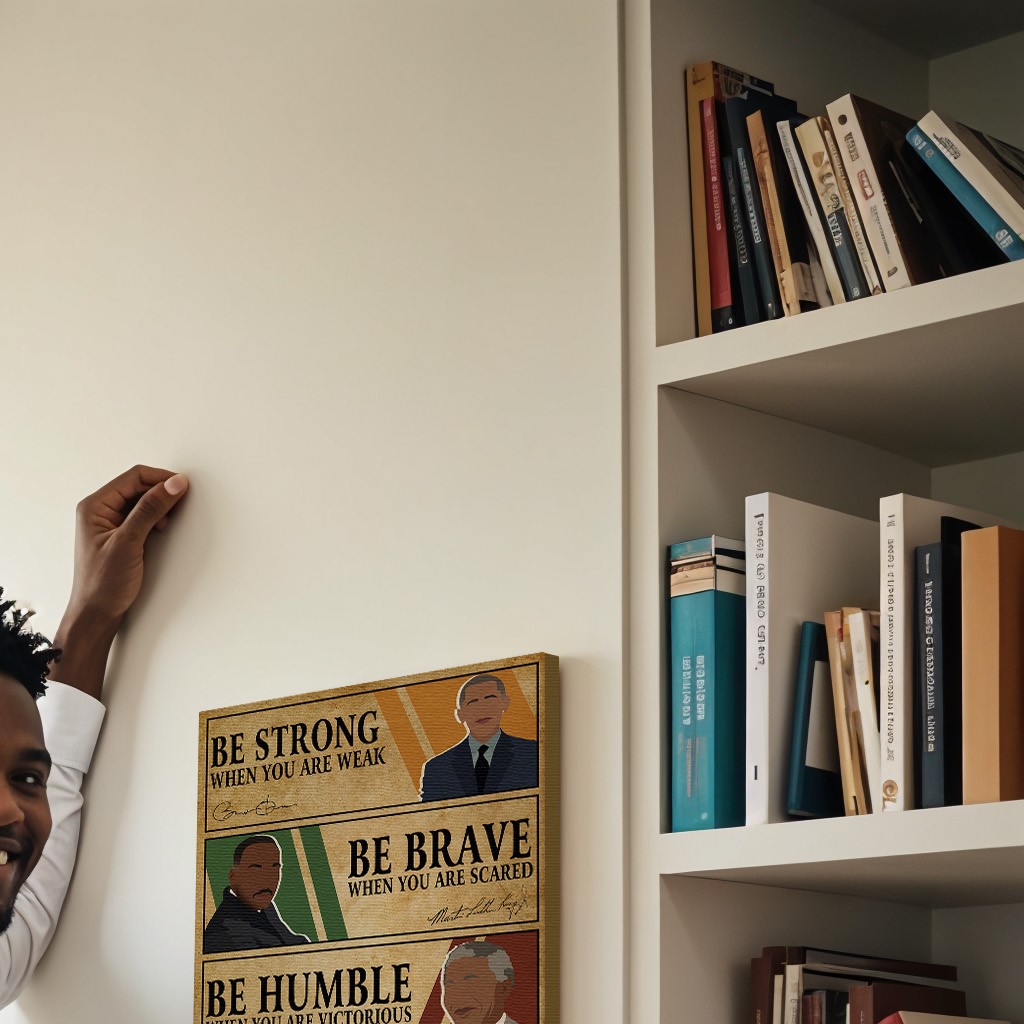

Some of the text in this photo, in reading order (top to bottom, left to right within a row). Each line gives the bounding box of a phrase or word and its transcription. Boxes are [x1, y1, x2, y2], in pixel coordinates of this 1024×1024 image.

[210, 710, 380, 769] BE STRONG
[210, 745, 386, 790] WHEN YOU ARE WEAK
[347, 817, 532, 879] BE BRAVE
[347, 861, 534, 898] WHEN YOU ARE SCARED
[206, 963, 412, 1018] BE HUMBLE
